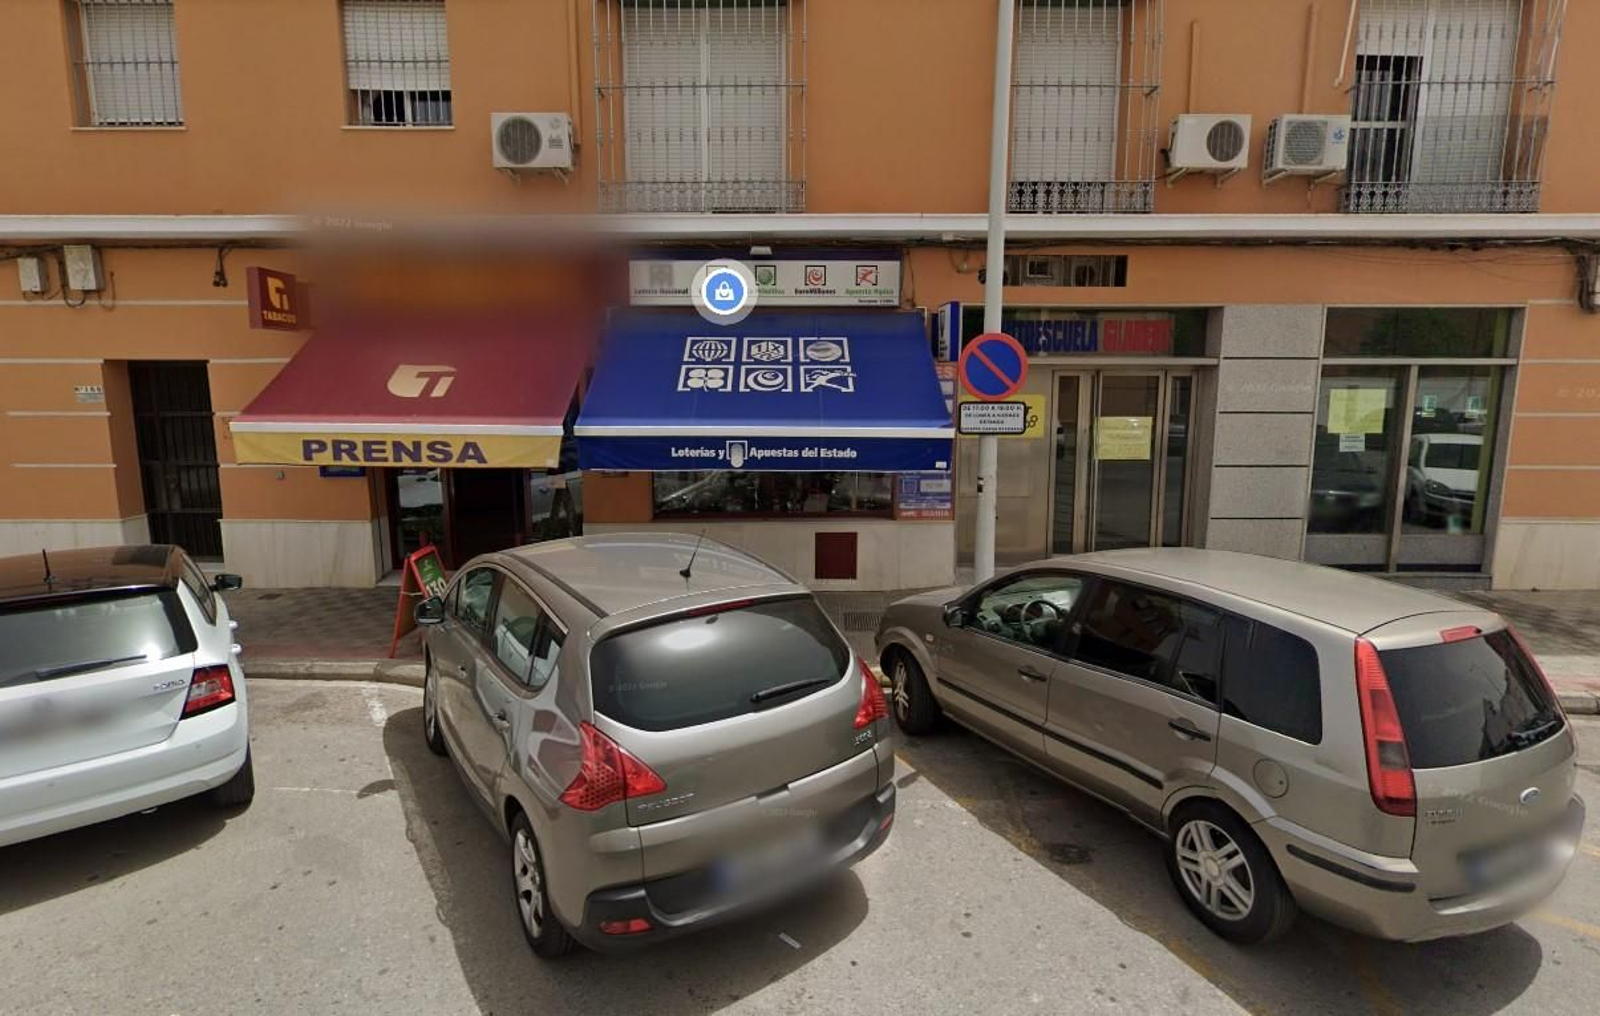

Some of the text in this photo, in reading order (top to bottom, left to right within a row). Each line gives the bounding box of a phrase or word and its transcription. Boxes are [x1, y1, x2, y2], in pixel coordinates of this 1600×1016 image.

[263, 310, 297, 324] TABACOS
[302, 438, 488, 464] PRENSA
[671, 447, 857, 460] Loterías y Apuestas del Estado
